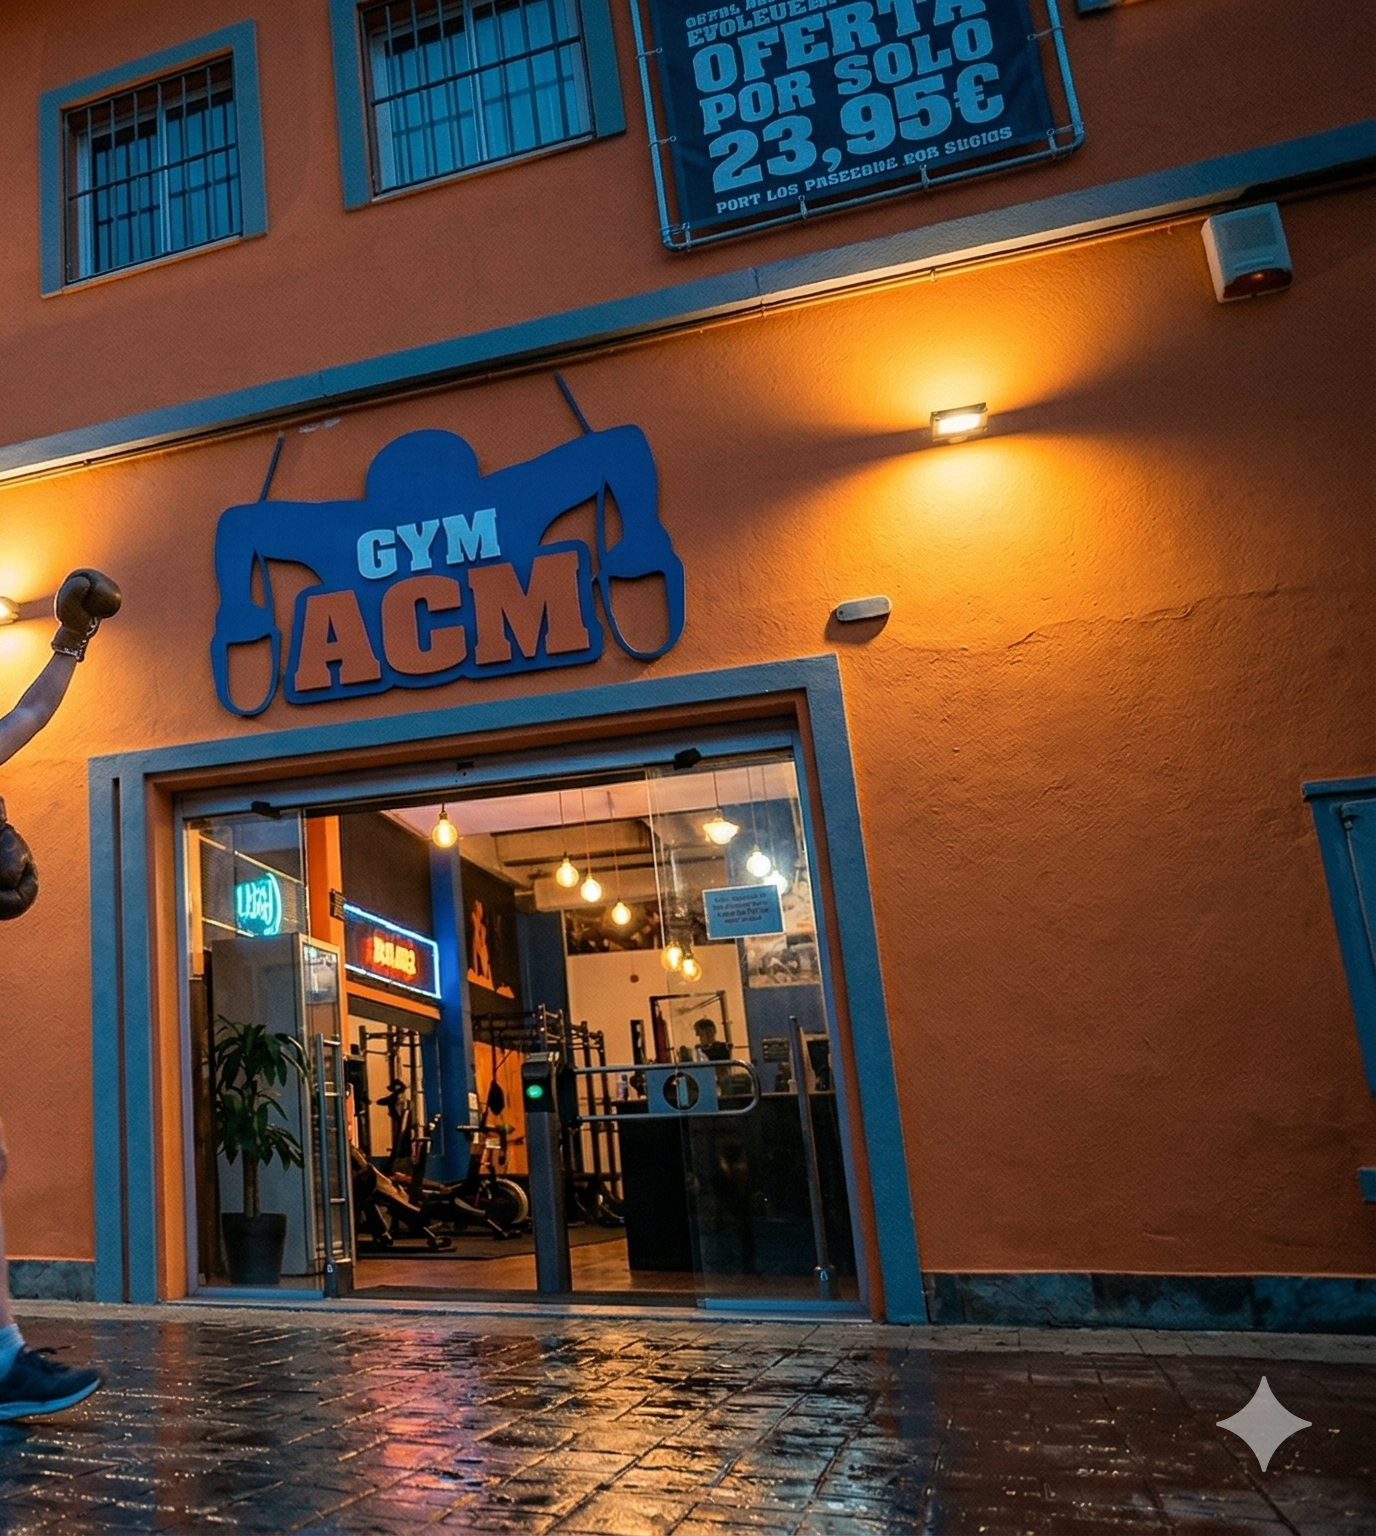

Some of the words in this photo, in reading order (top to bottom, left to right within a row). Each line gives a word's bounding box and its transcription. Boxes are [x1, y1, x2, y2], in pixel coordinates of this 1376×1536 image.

[699, 70, 816, 136] POR
[833, 17, 994, 96] SOLO
[708, 62, 1005, 194] 23,95€
[716, 193, 761, 214] PORT
[766, 183, 799, 202] LOS
[357, 507, 501, 580] GYM
[294, 550, 591, 692] ACM
